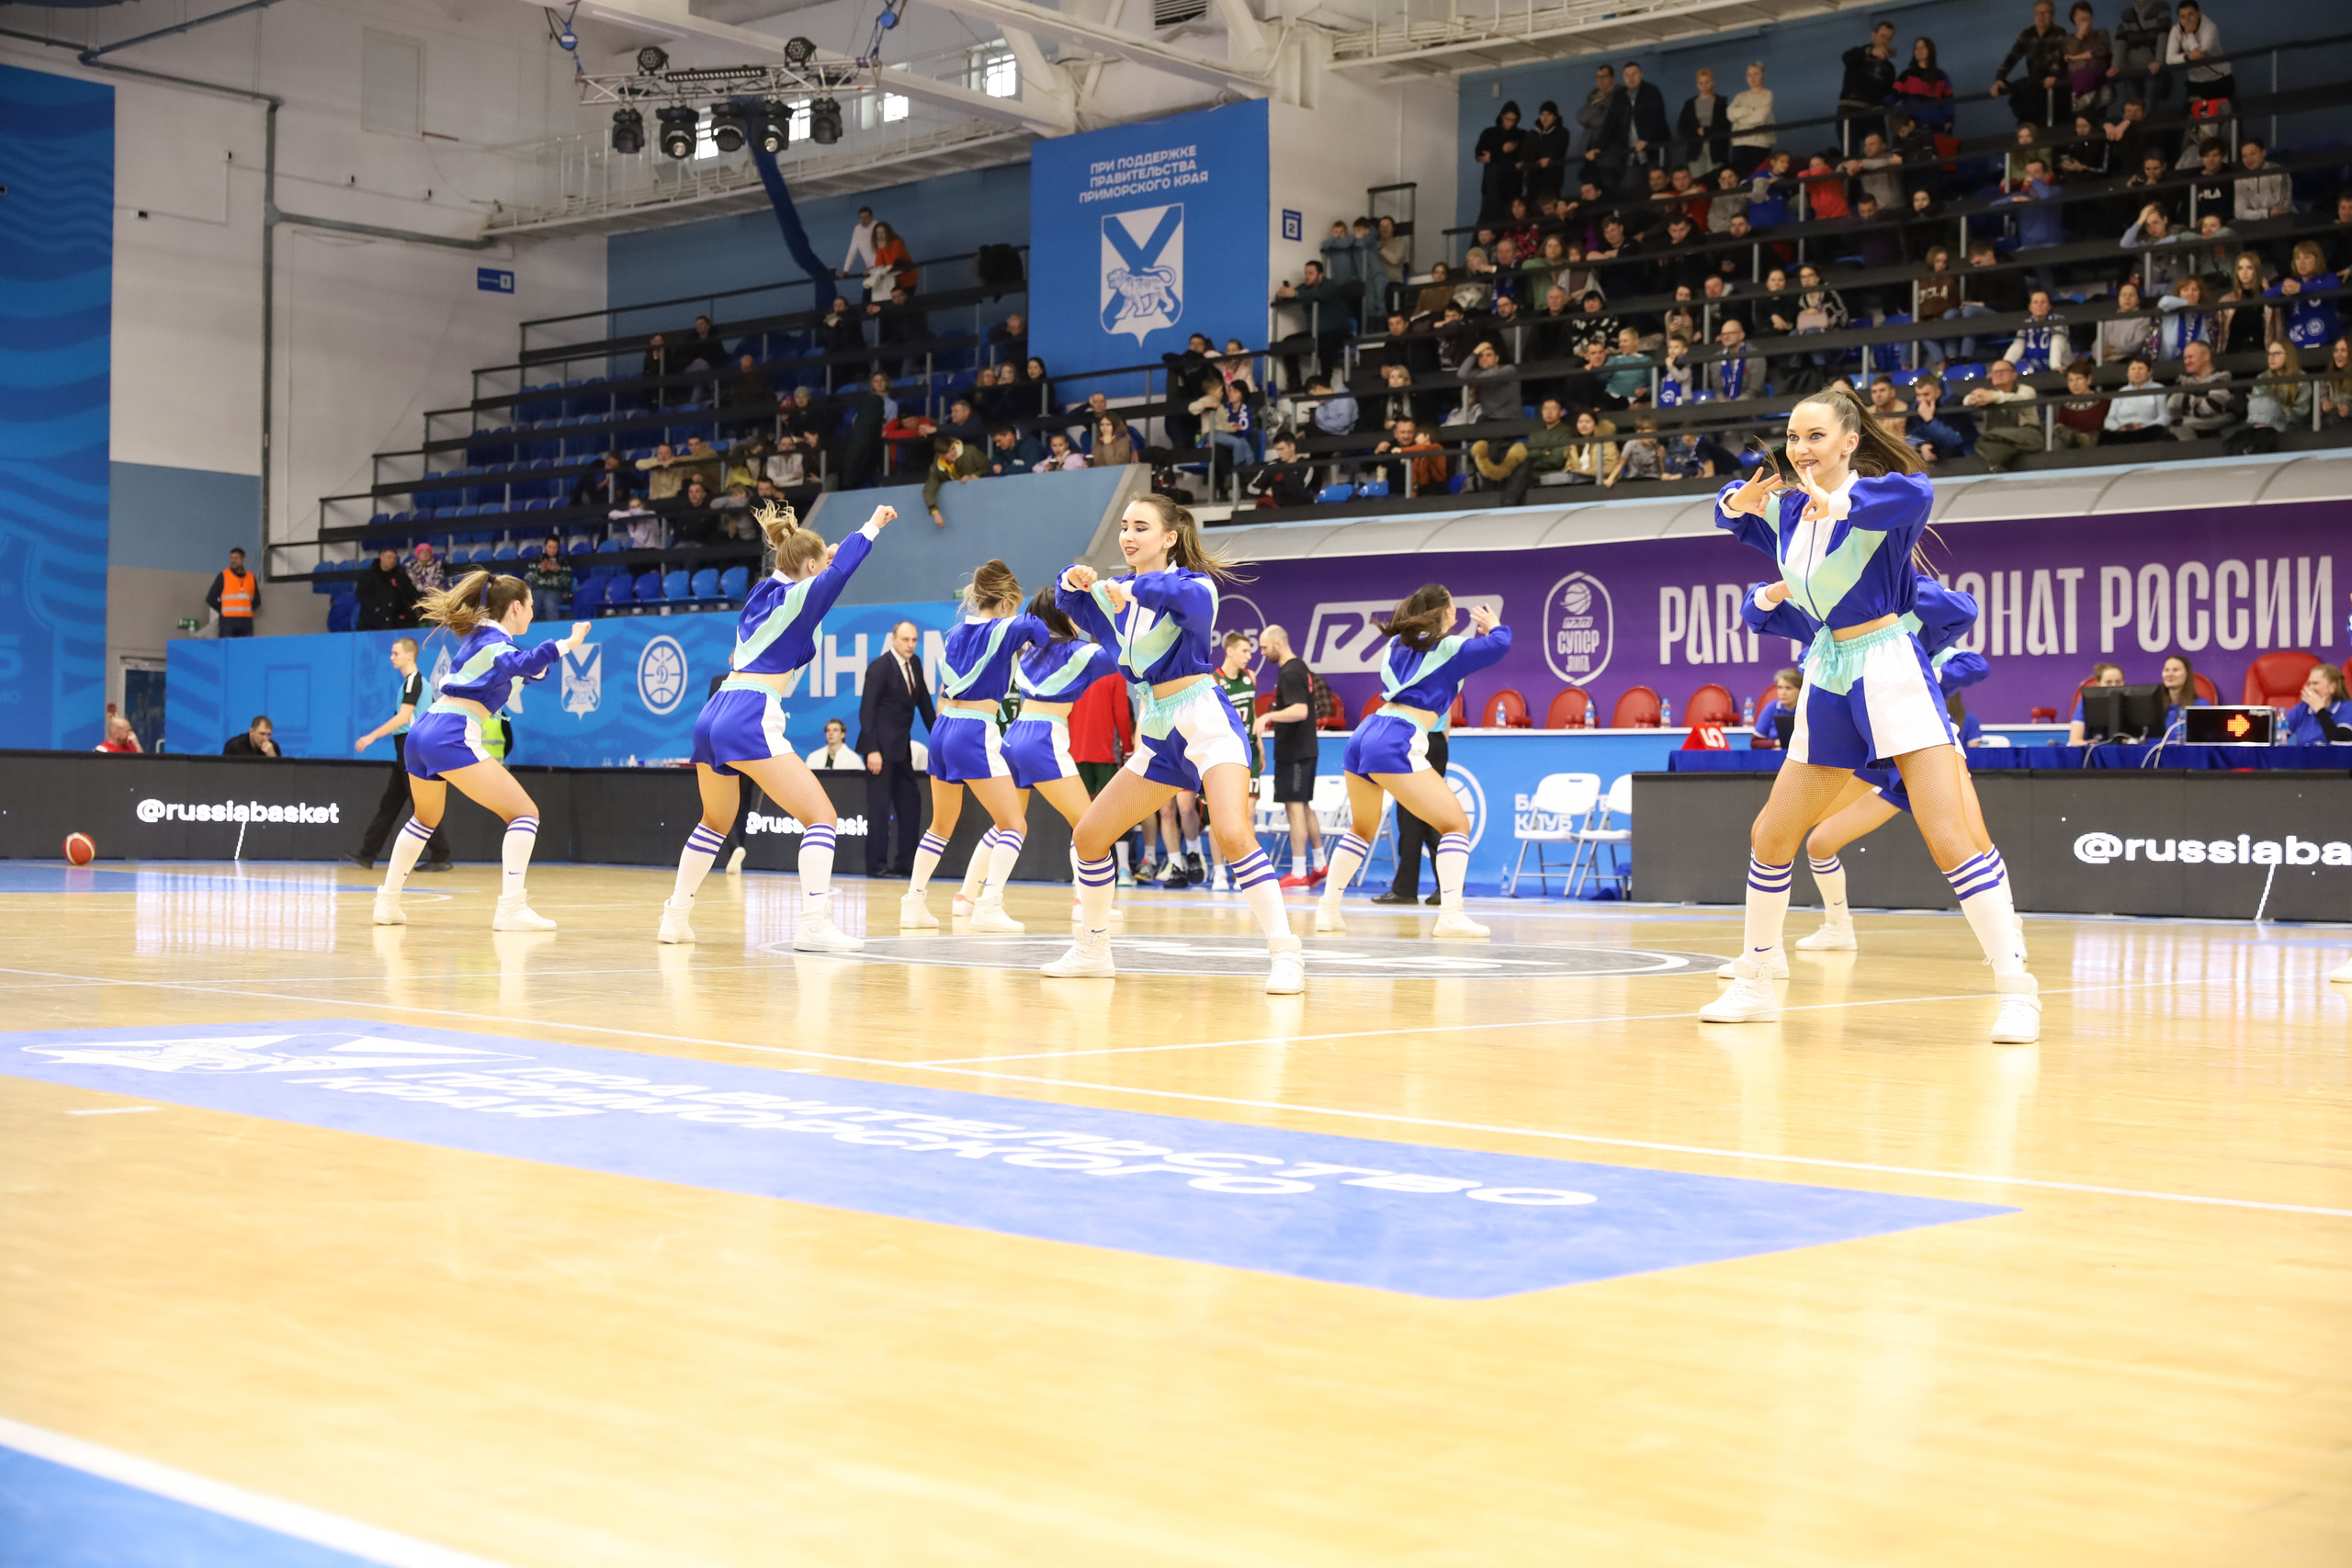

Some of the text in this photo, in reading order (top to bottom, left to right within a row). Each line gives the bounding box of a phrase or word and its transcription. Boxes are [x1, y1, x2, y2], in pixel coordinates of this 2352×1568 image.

[1090, 144, 1197, 175] ПРИ ПОДДЕРЖКЕ
[1090, 159, 1197, 189] ПРАВИТЕЛЬСТВА
[1079, 170, 1209, 204] ПРИМОРСКОГО КРАЯ
[1288, 222, 1296, 234] 2
[1556, 629, 1600, 655] СУПЕР
[137, 798, 340, 824] @russiabasket
[282, 1077, 607, 1118] КРАЯ
[383, 1071, 1317, 1194] ПРИМОРСКОГО
[479, 1066, 1599, 1206] ПРАВИТЕЛЬСТВО
